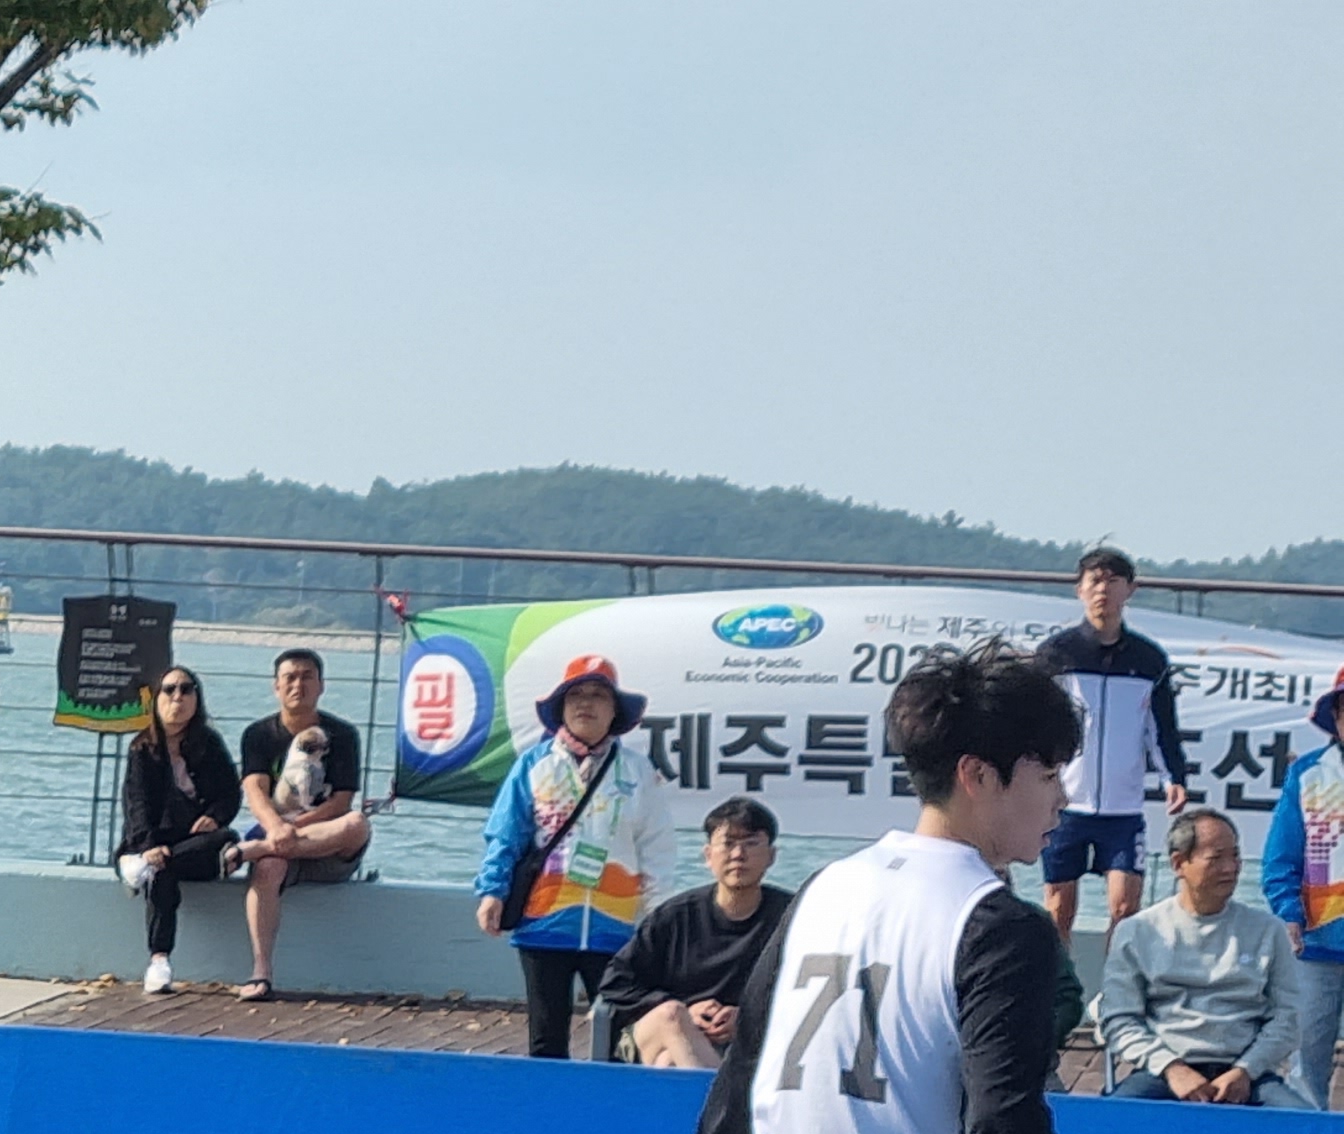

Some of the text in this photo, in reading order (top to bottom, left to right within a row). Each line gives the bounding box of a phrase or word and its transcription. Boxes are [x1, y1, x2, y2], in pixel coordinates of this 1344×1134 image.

[737, 615, 796, 634] APEC
[721, 656, 803, 669] Asia-Pacific
[684, 670, 839, 685] Economic Cooperation
[775, 952, 891, 1104] 71
